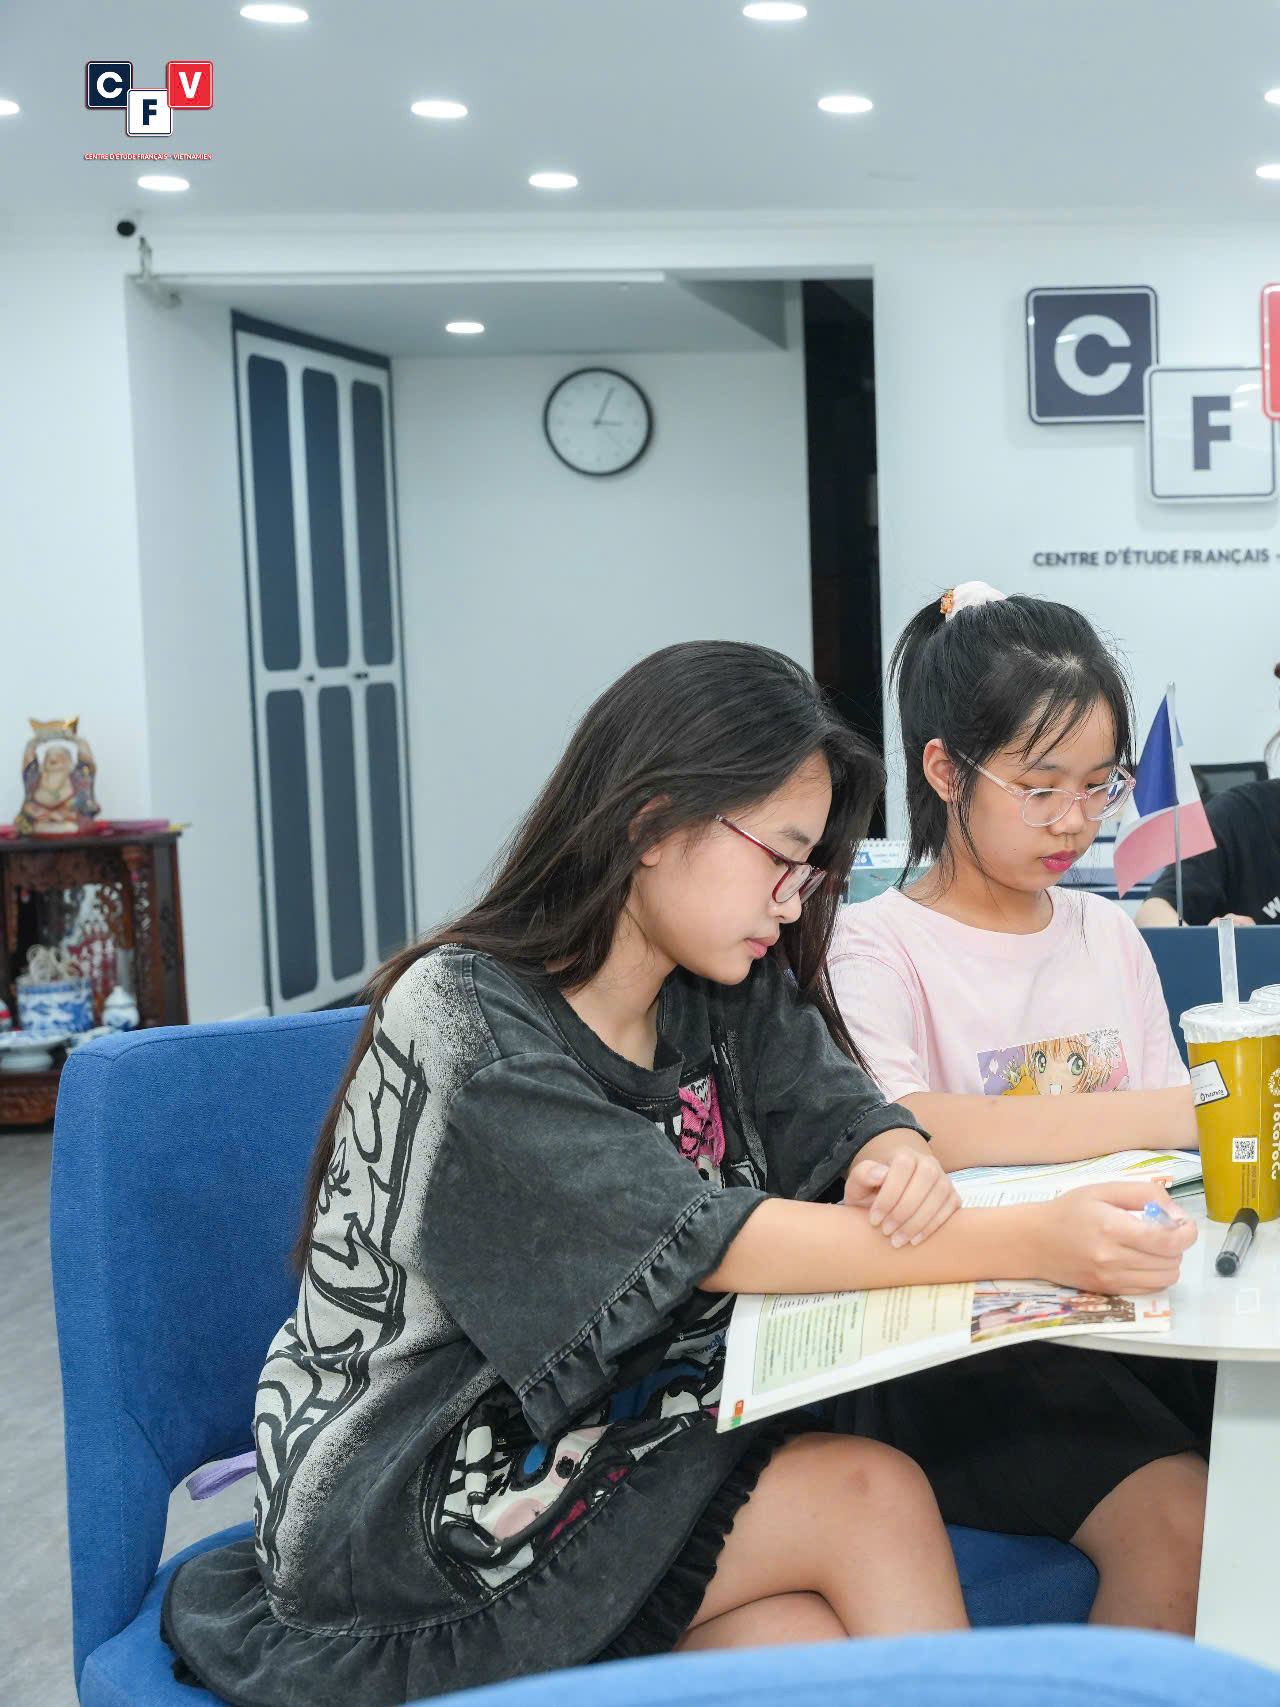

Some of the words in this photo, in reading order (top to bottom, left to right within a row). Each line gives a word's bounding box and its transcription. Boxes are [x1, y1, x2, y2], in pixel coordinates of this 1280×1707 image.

[1054, 314, 1132, 396] C
[1191, 395, 1231, 471] F
[1033, 551, 1100, 567] CENTRE
[1104, 546, 1179, 566] D'ÉTUDE
[1183, 547, 1270, 567] FRANÇAIS
